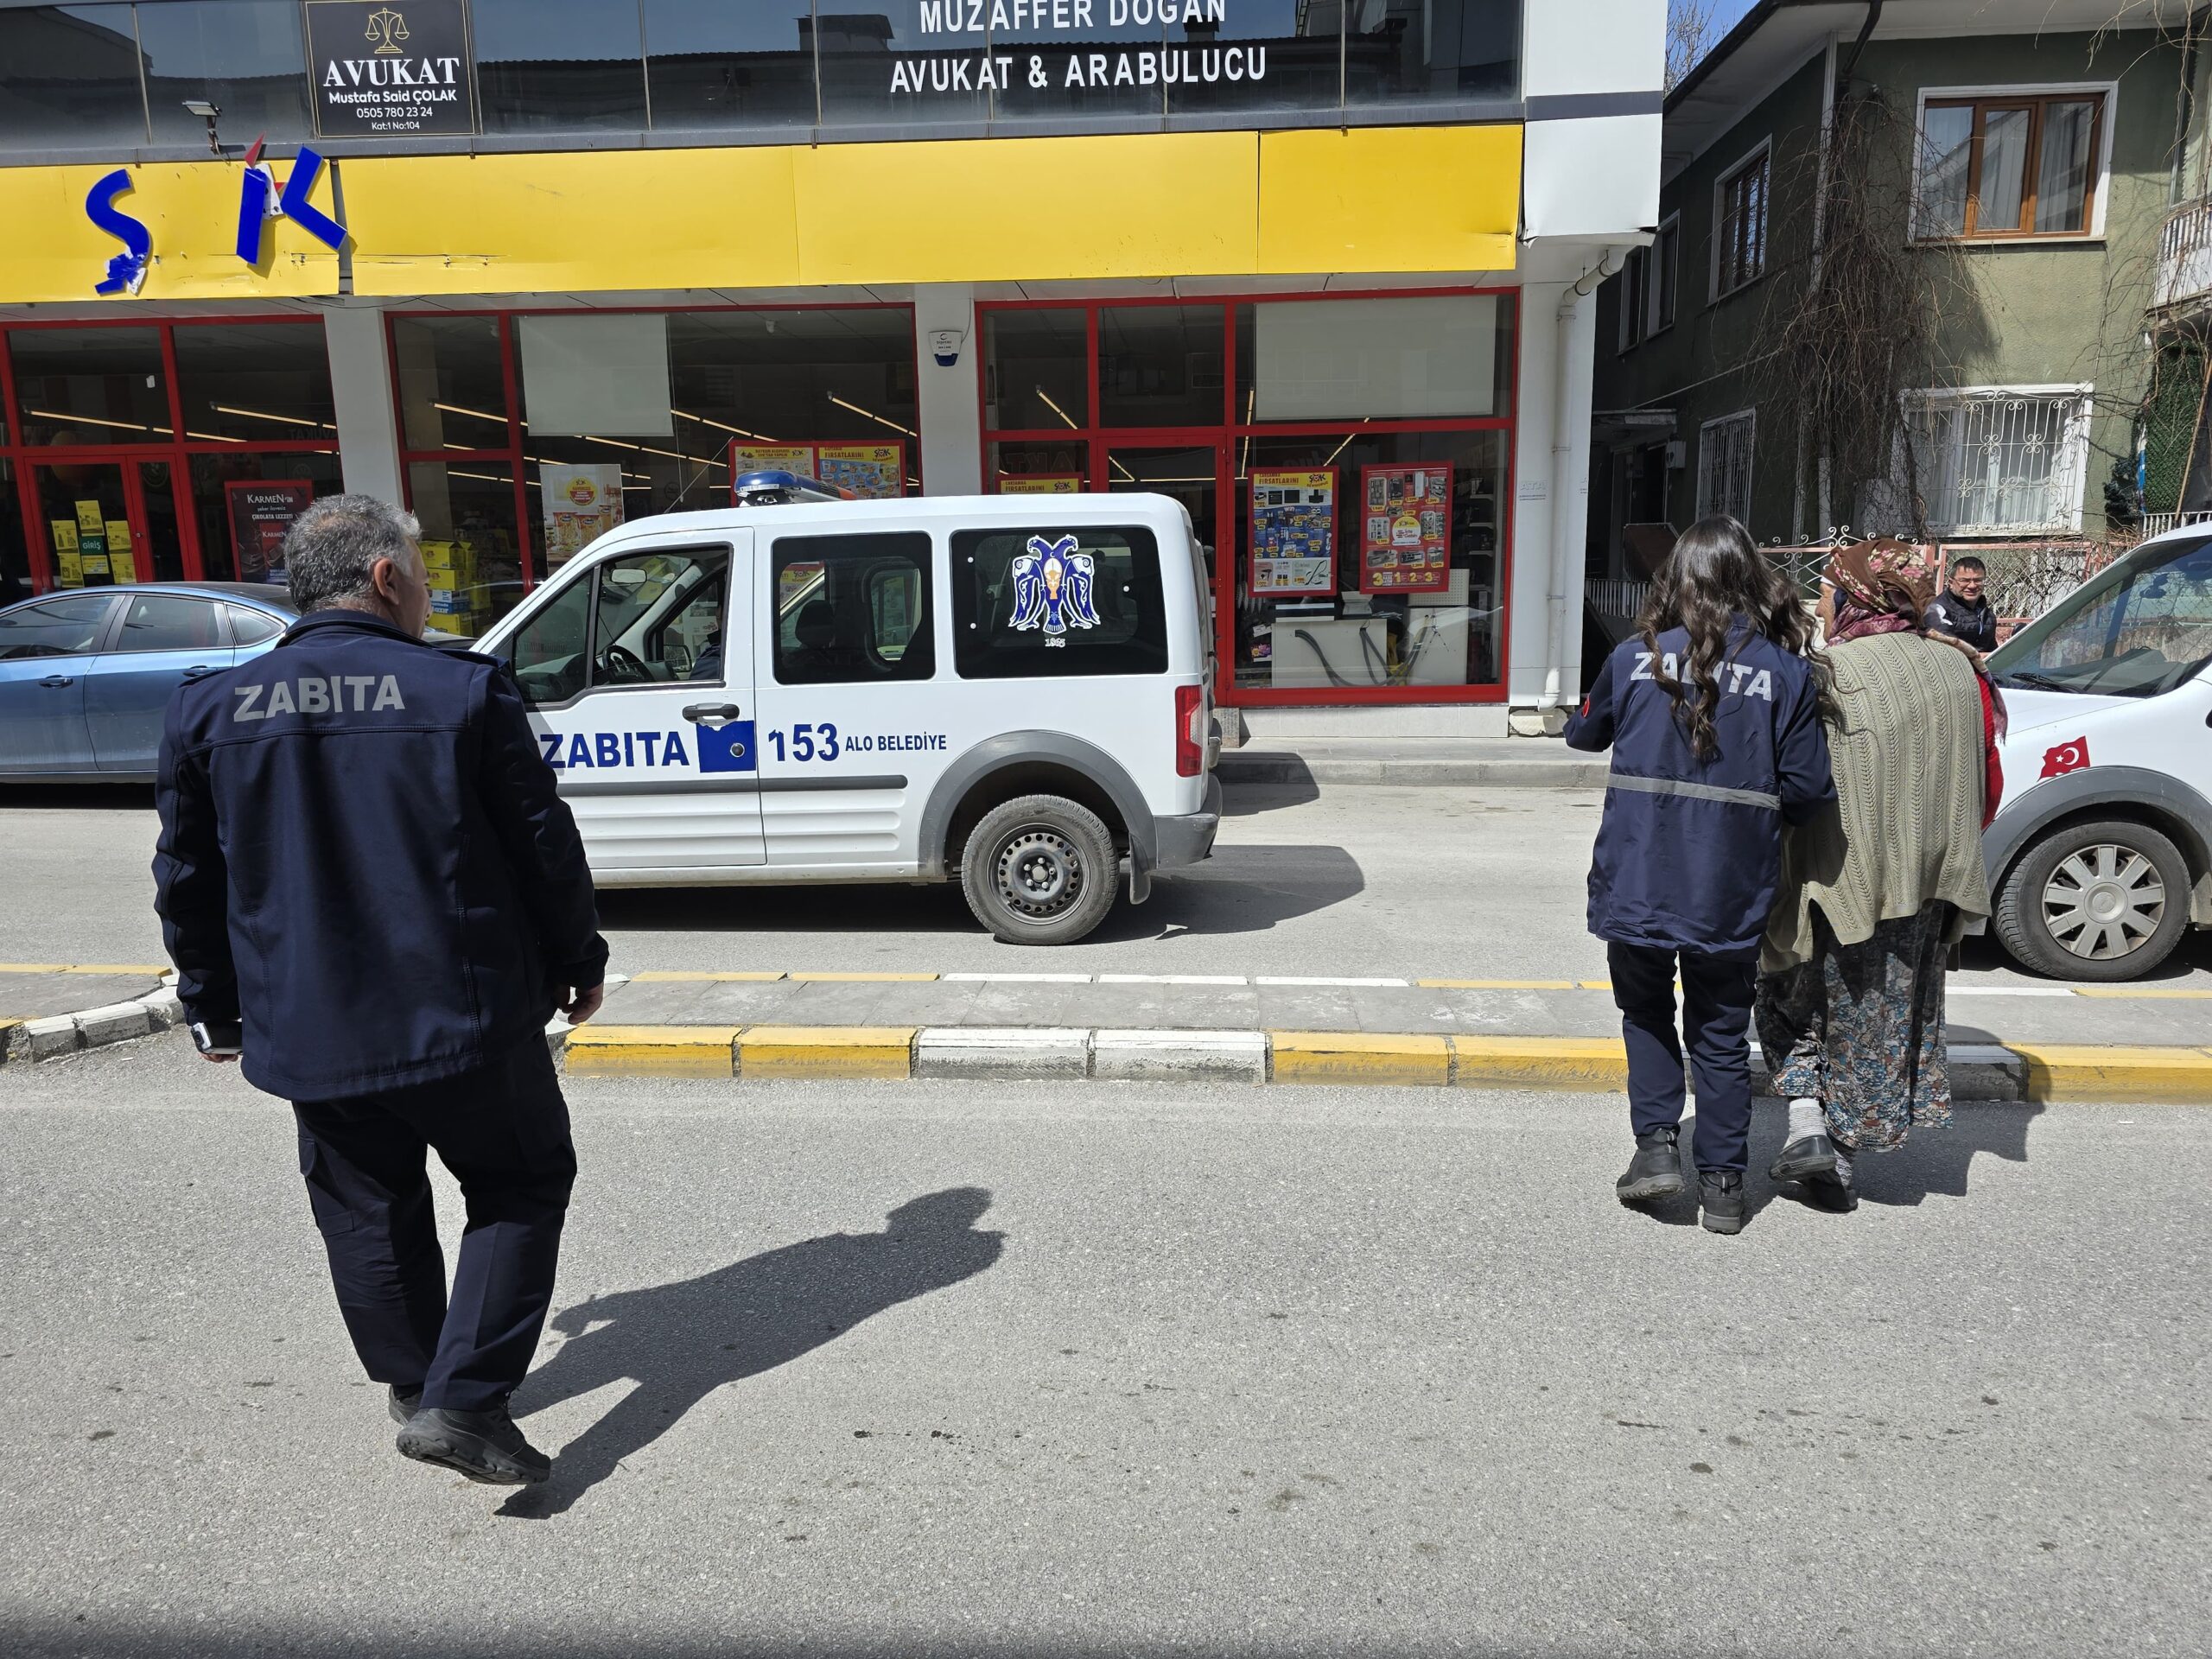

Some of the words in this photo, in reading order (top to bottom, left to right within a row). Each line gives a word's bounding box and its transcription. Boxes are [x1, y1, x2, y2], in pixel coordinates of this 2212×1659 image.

[323, 57, 460, 86] AVUKAT
[890, 57, 1013, 92] AVUKAT
[1028, 55, 1048, 88] &
[1065, 47, 1266, 87] ARABULUCU
[328, 91, 380, 104] Mustafa
[383, 90, 410, 103] Said
[413, 89, 457, 105] ÇOLAK
[356, 108, 383, 118] 0505
[385, 107, 404, 118] 780
[406, 107, 418, 117] 23
[420, 106, 433, 117] 24
[393, 121, 420, 130] No:104
[82, 540, 101, 550] GİRİŞ
[233, 675, 405, 722] ZABITA
[540, 731, 690, 769] ZABITA
[768, 722, 840, 762] 153
[845, 735, 874, 752] ALO
[877, 730, 947, 751] BELEDİYE
